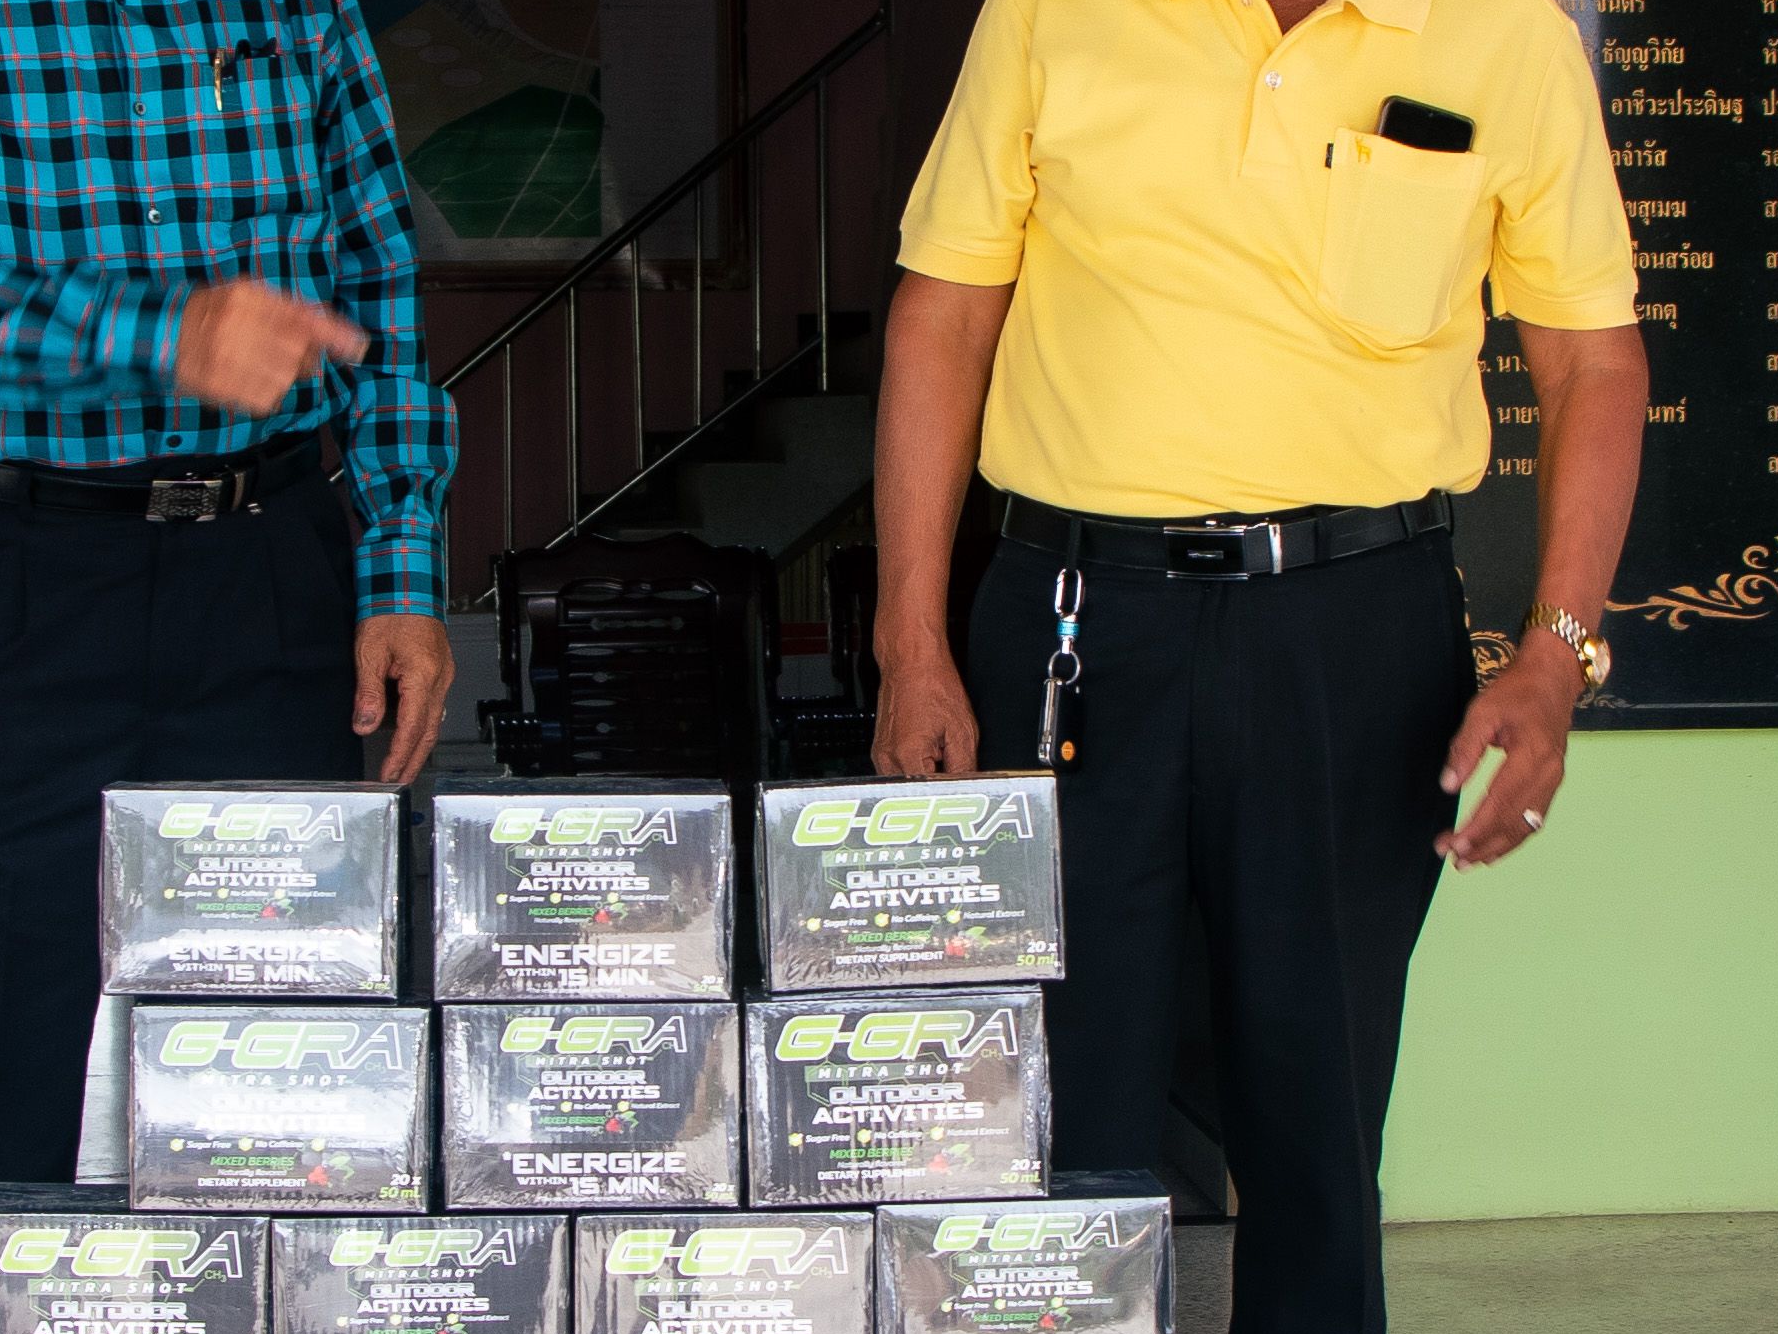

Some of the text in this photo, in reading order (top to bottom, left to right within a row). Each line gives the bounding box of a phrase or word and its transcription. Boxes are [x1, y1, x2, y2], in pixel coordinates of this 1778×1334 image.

[159, 803, 344, 842] G-GRA
[490, 807, 677, 846] G-GRA
[791, 792, 1034, 847] G-GRA
[193, 842, 305, 853] MITRA SHOT
[834, 846, 979, 865] MITRA SHOT
[199, 857, 304, 873] OUTDOOR
[530, 861, 636, 877] OUTDOOR
[184, 873, 317, 888] ACTIVITIES
[517, 877, 650, 892] ACTIVITIES
[846, 867, 981, 889] OUTDOOR
[830, 885, 1001, 910] ACTIVITIES
[1027, 940, 1044, 953] 20
[835, 951, 944, 965] DIETARY SUPPLEMENT
[1016, 955, 1037, 966] 50
[559, 968, 589, 987] 15
[501, 1016, 687, 1055] G-GRA
[775, 1009, 1018, 1062] G-GRA
[159, 1020, 403, 1071] G-GRA
[541, 1070, 647, 1086] OUTDOOR
[818, 1063, 963, 1079] MITRA SHOT
[288, 1073, 348, 1086] SHOT
[528, 1086, 660, 1101] ACTIVITIES
[830, 1084, 964, 1105] OUTDOOR
[812, 1102, 985, 1125] ACTIVITIES
[198, 1176, 307, 1188] DIETARY SUPPLEMENT
[390, 1173, 408, 1186] 20
[571, 1177, 602, 1195] 15
[379, 1187, 401, 1199] 50
[933, 1211, 1119, 1252] G-GRA
[330, 1228, 516, 1266] G-GRA
[605, 1227, 849, 1276] G-GRA
[973, 1267, 1079, 1282] OUTDOOR
[40, 1282, 188, 1294] MITRA SHOT
[369, 1283, 475, 1298] OUTDOOR
[647, 1281, 793, 1294] MITRA SHOT
[962, 1281, 1094, 1297] ACTIVITIES
[50, 1301, 188, 1319] OUTDOOR
[357, 1298, 490, 1313] ACTIVITIES
[658, 1301, 793, 1318] OUTDOOR
